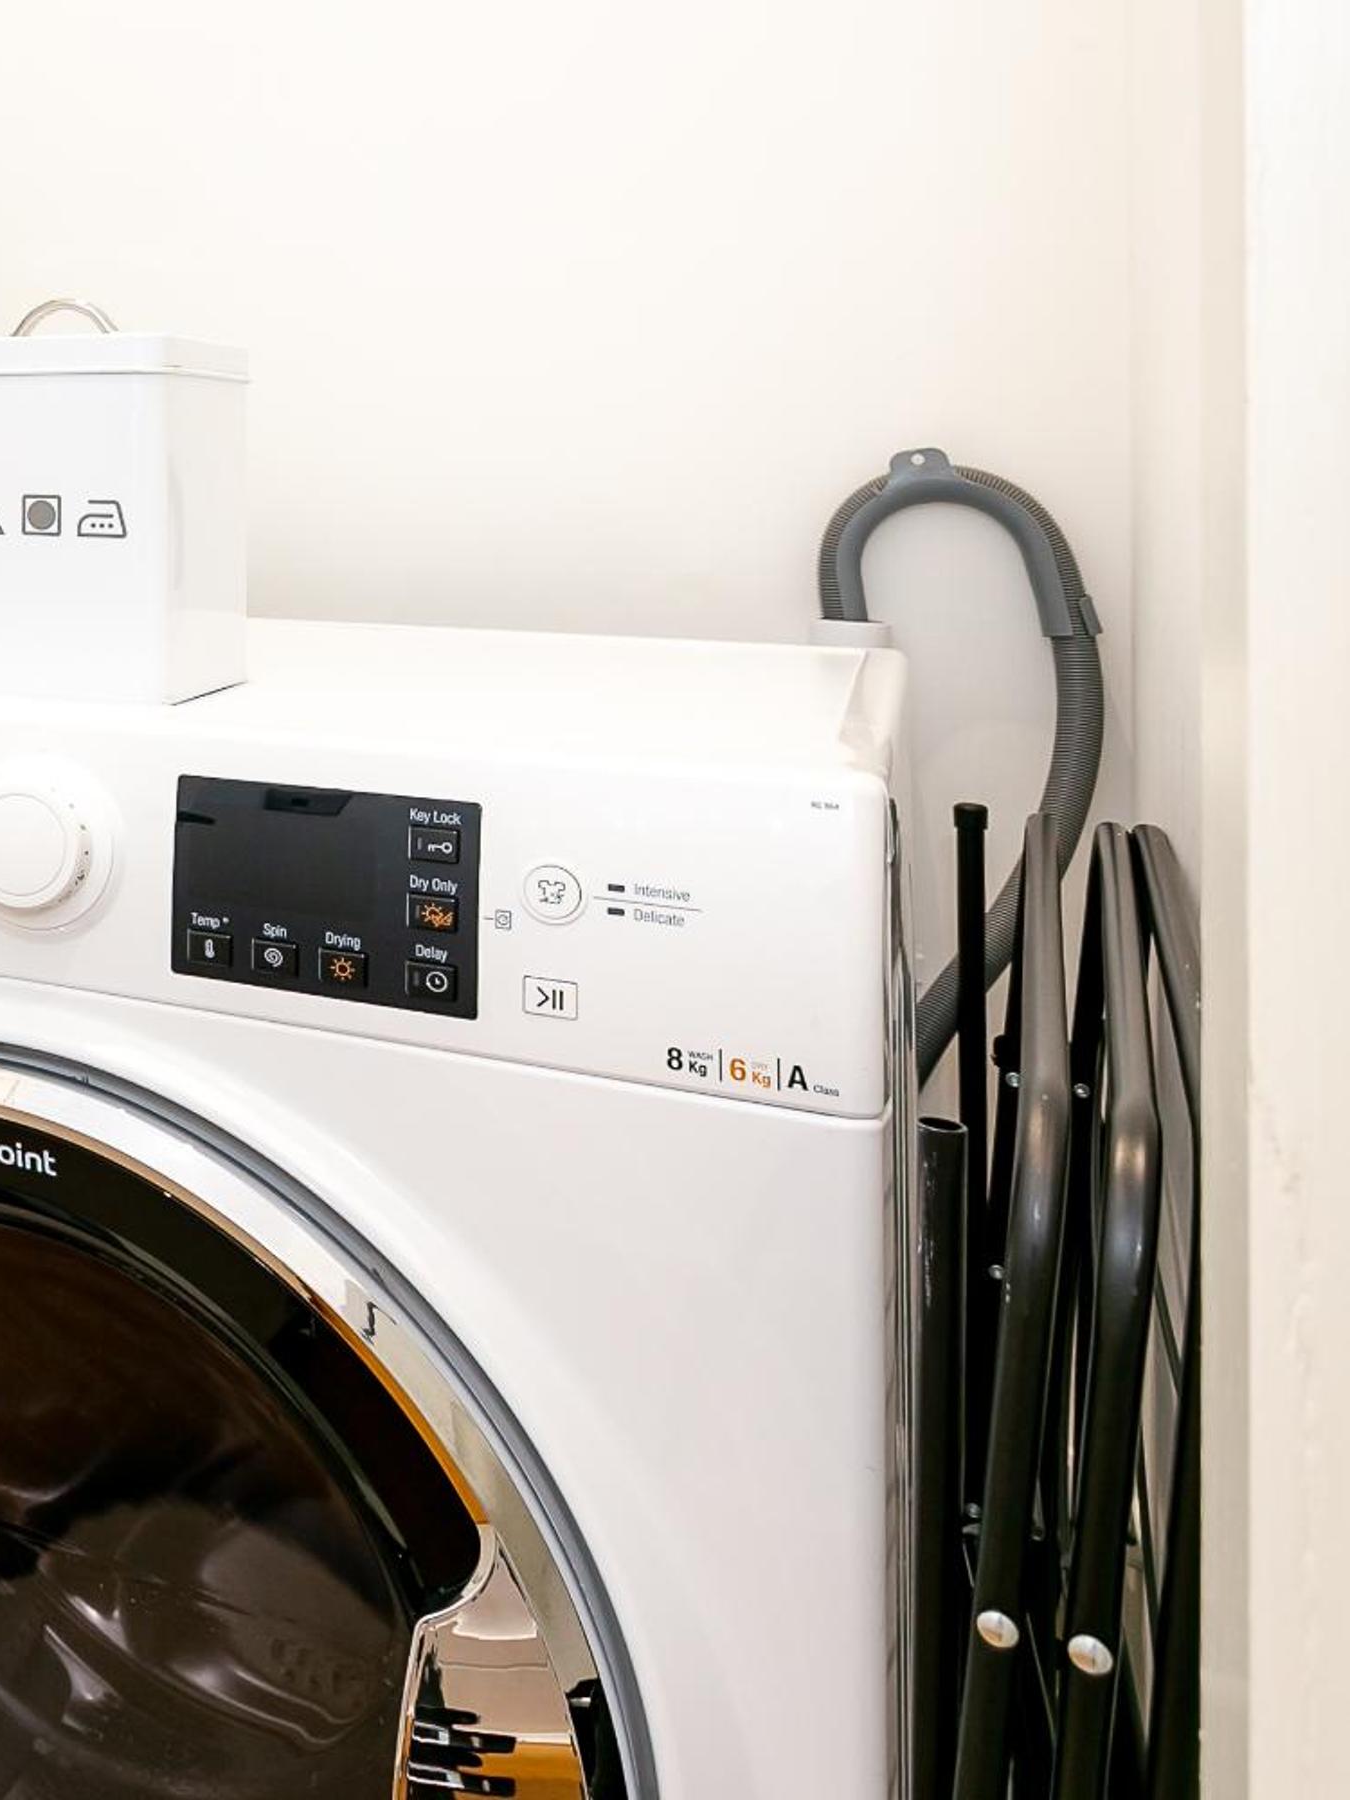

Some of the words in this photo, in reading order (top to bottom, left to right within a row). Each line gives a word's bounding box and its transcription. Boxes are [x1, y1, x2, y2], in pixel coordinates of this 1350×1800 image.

[409, 808, 431, 826] Key
[433, 809, 462, 826] Lock
[409, 875, 430, 892] Dry
[432, 877, 458, 895] Only
[634, 883, 691, 902] Intensive
[190, 912, 221, 929] Temp
[633, 908, 685, 927] Delicate
[262, 922, 288, 938] Spin
[325, 932, 361, 950] Drying
[415, 944, 448, 963] Delay
[666, 1046, 684, 1071] 8
[688, 1061, 708, 1077] Kg
[687, 1050, 714, 1062] WASH
[729, 1057, 747, 1081] 6
[751, 1071, 772, 1089] Kg
[787, 1064, 810, 1092] A
[813, 1084, 840, 1097] Class
